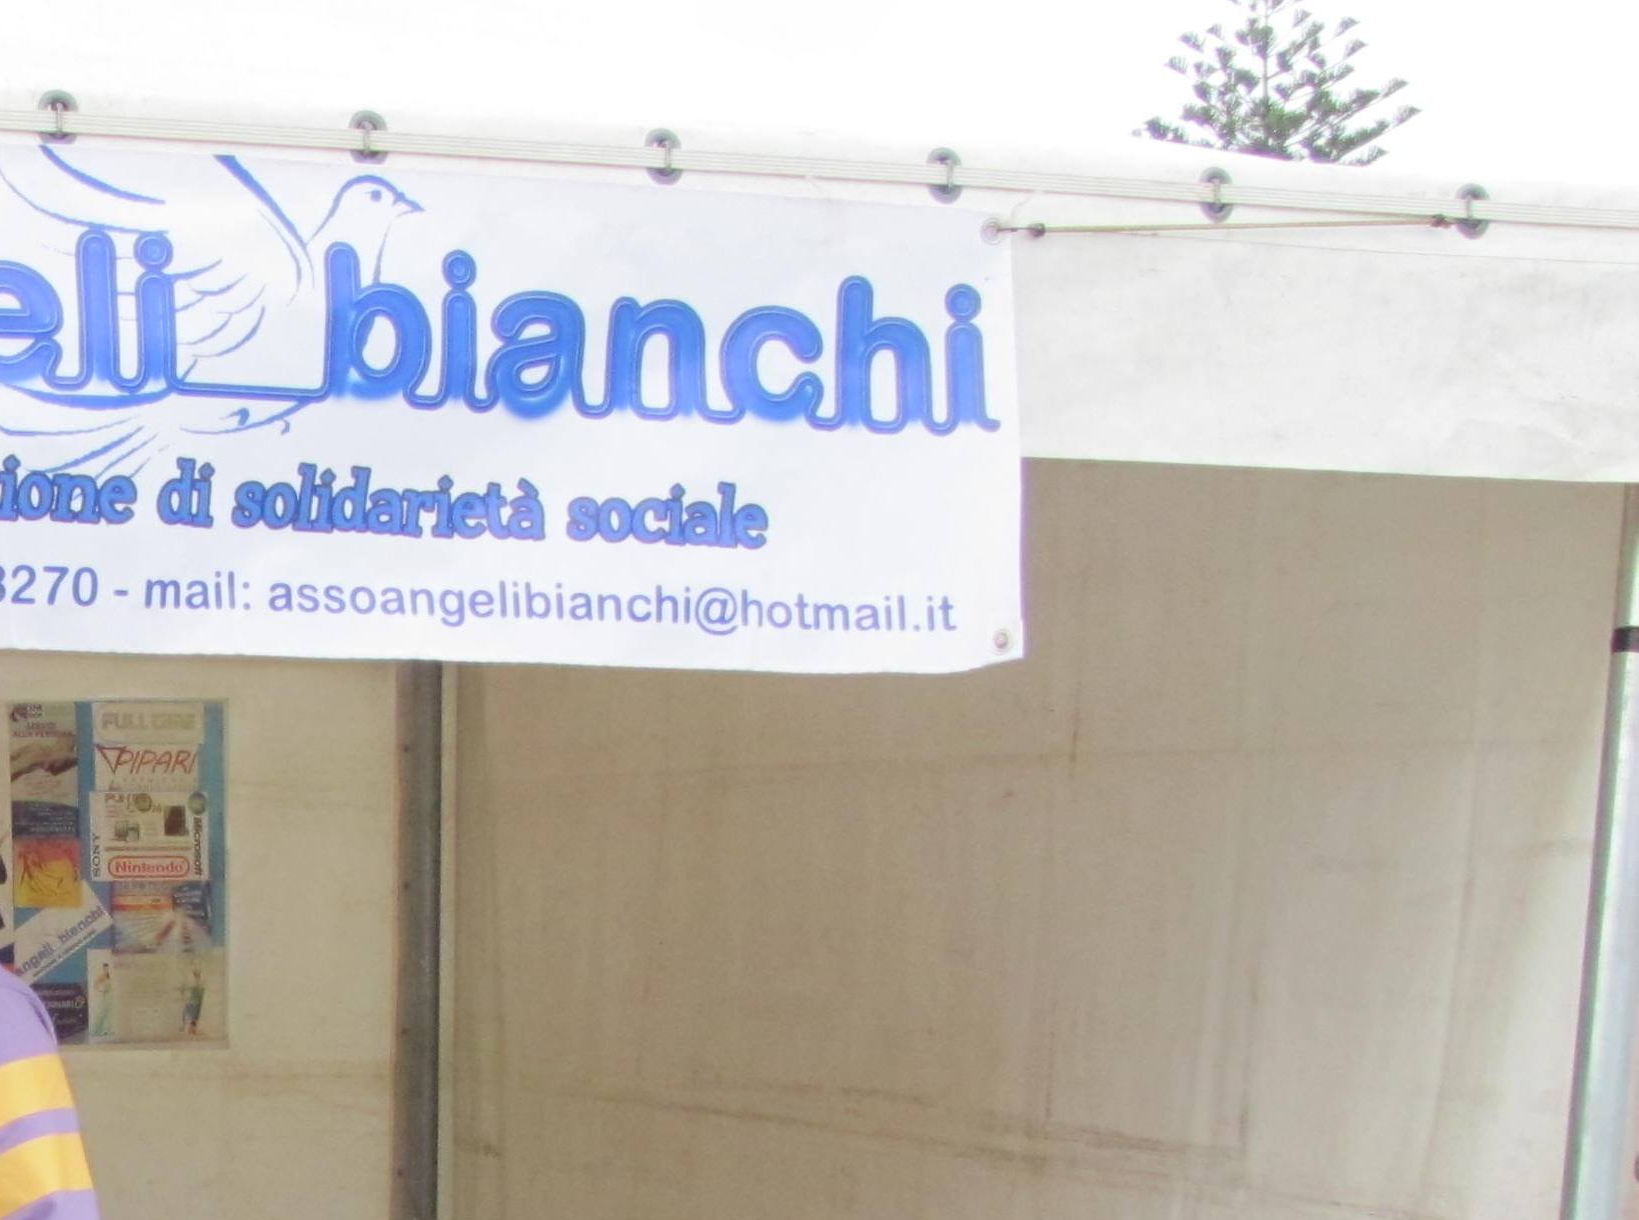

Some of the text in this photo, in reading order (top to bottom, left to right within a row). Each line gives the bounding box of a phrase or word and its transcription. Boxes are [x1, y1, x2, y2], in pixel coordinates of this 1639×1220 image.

[323, 240, 1002, 436] bianchi
[157, 455, 214, 529] di
[230, 461, 545, 541] solidarietà
[566, 482, 768, 550] sociale
[143, 568, 254, 610] mail:
[267, 577, 957, 638] assoangelibianchi@hotmail.it
[115, 860, 183, 873] Nintendo
